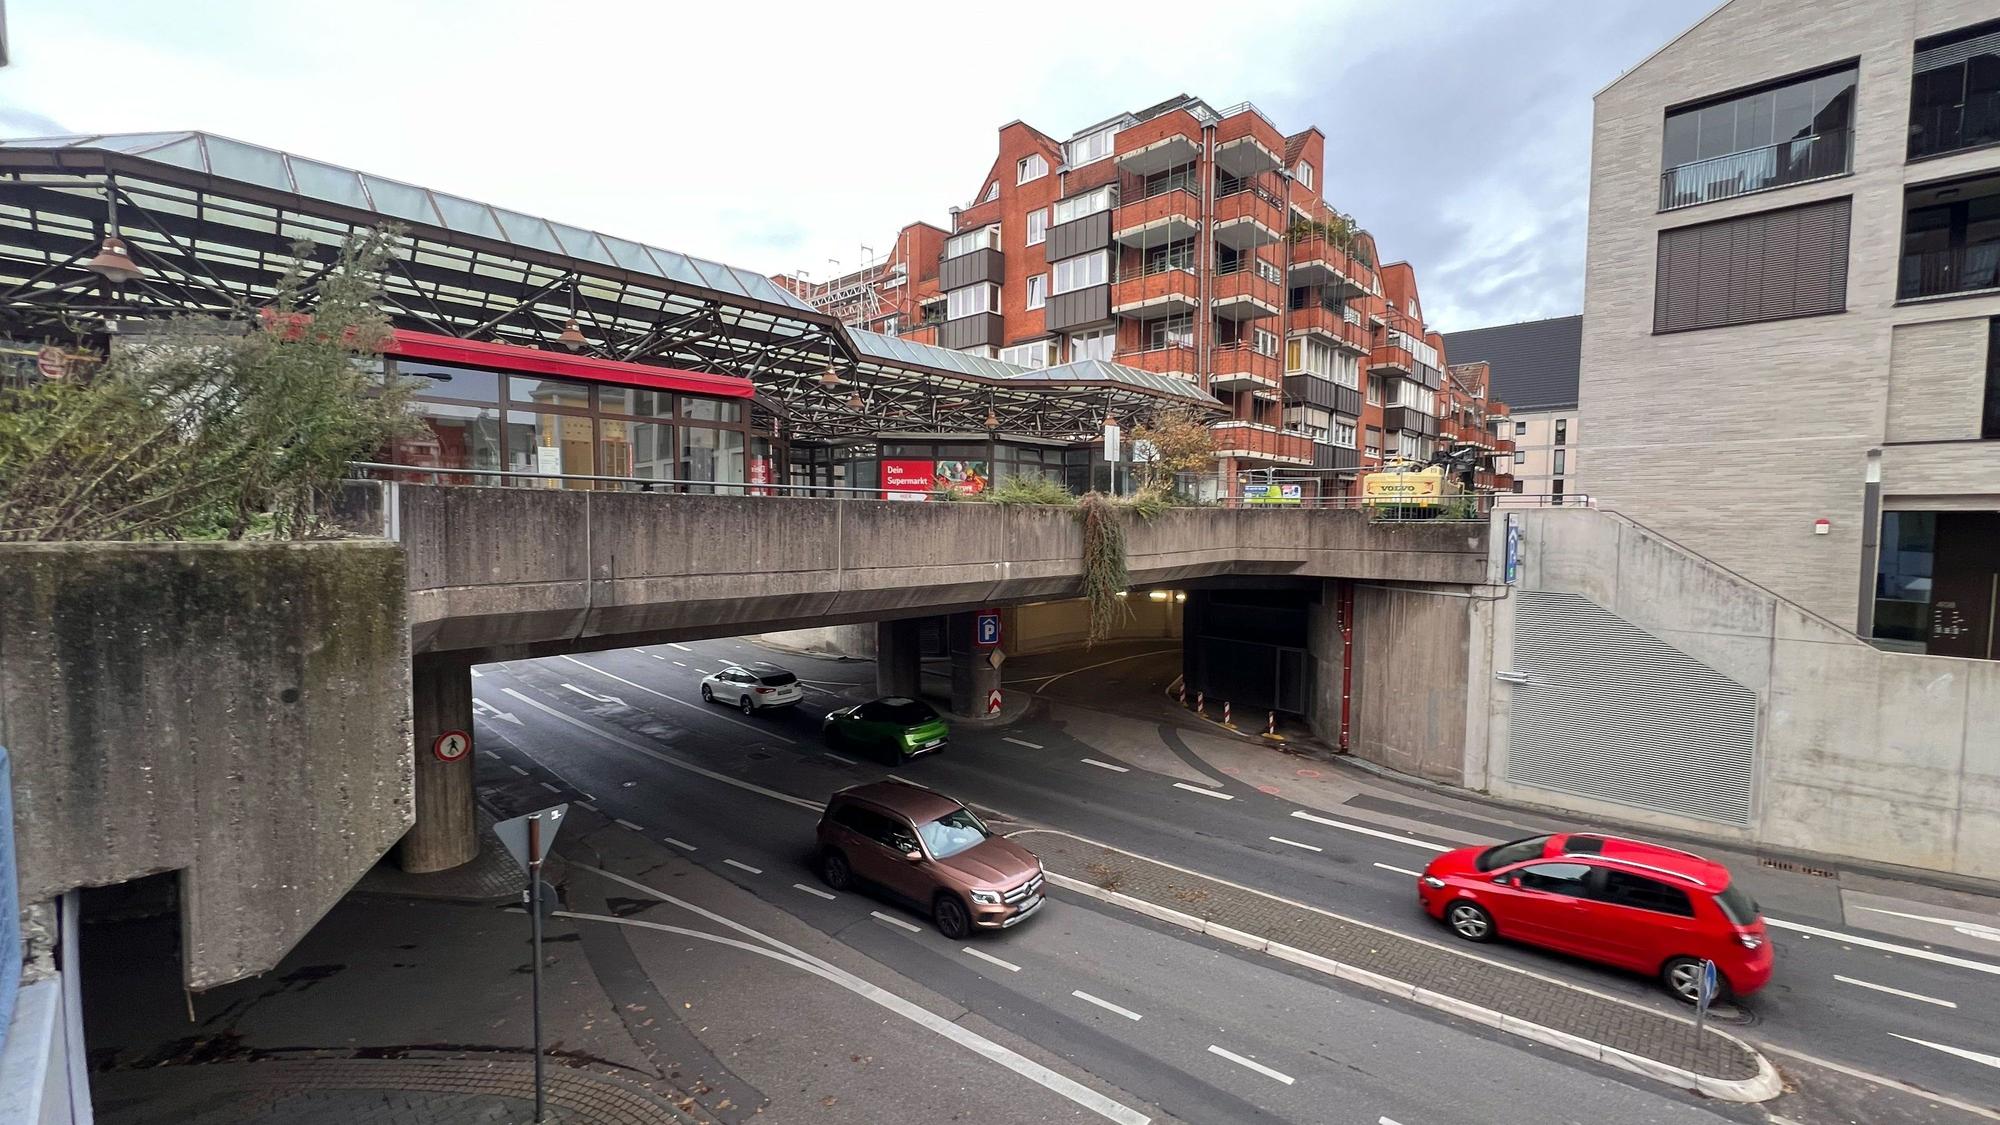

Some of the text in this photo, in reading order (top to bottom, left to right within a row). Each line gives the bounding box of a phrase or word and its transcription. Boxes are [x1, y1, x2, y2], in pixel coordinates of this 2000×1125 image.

[887, 466, 903, 474] Dein
[887, 478, 928, 486] Supermarkt
[984, 624, 995, 641] P
